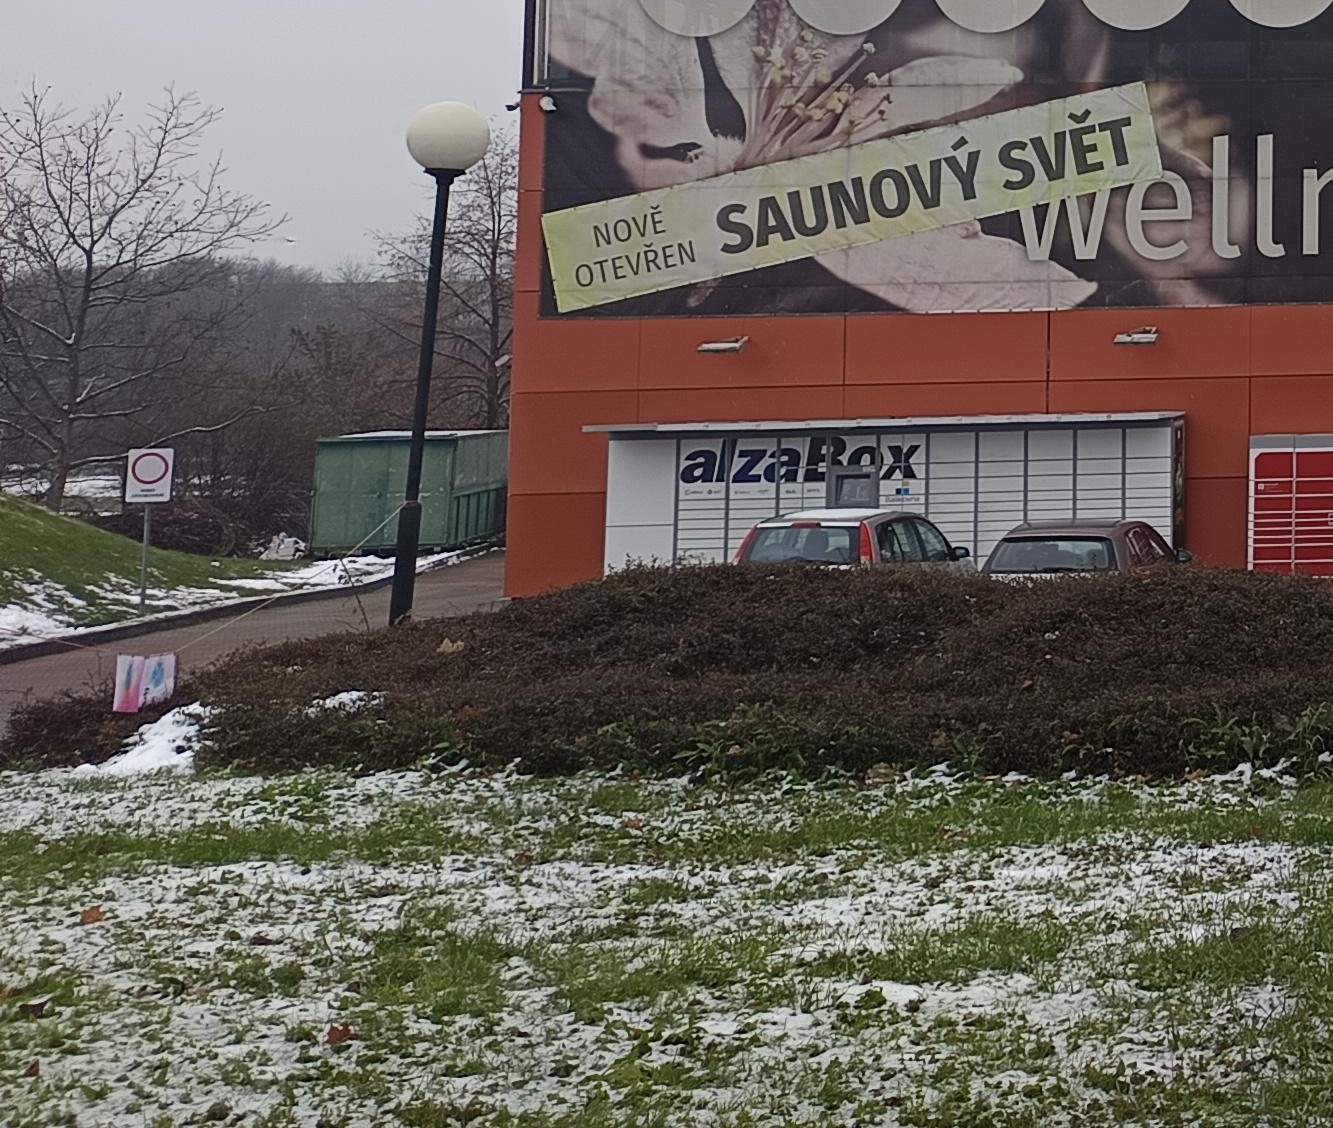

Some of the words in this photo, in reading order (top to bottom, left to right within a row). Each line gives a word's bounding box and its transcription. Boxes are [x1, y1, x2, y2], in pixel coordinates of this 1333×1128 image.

[716, 136, 981, 254] SAUNOVÝ
[1001, 109, 1132, 190] SVĚT
[592, 205, 667, 248] NOVĚ
[574, 239, 696, 288] OTEVŘEN
[680, 436, 921, 484] alzaBox
